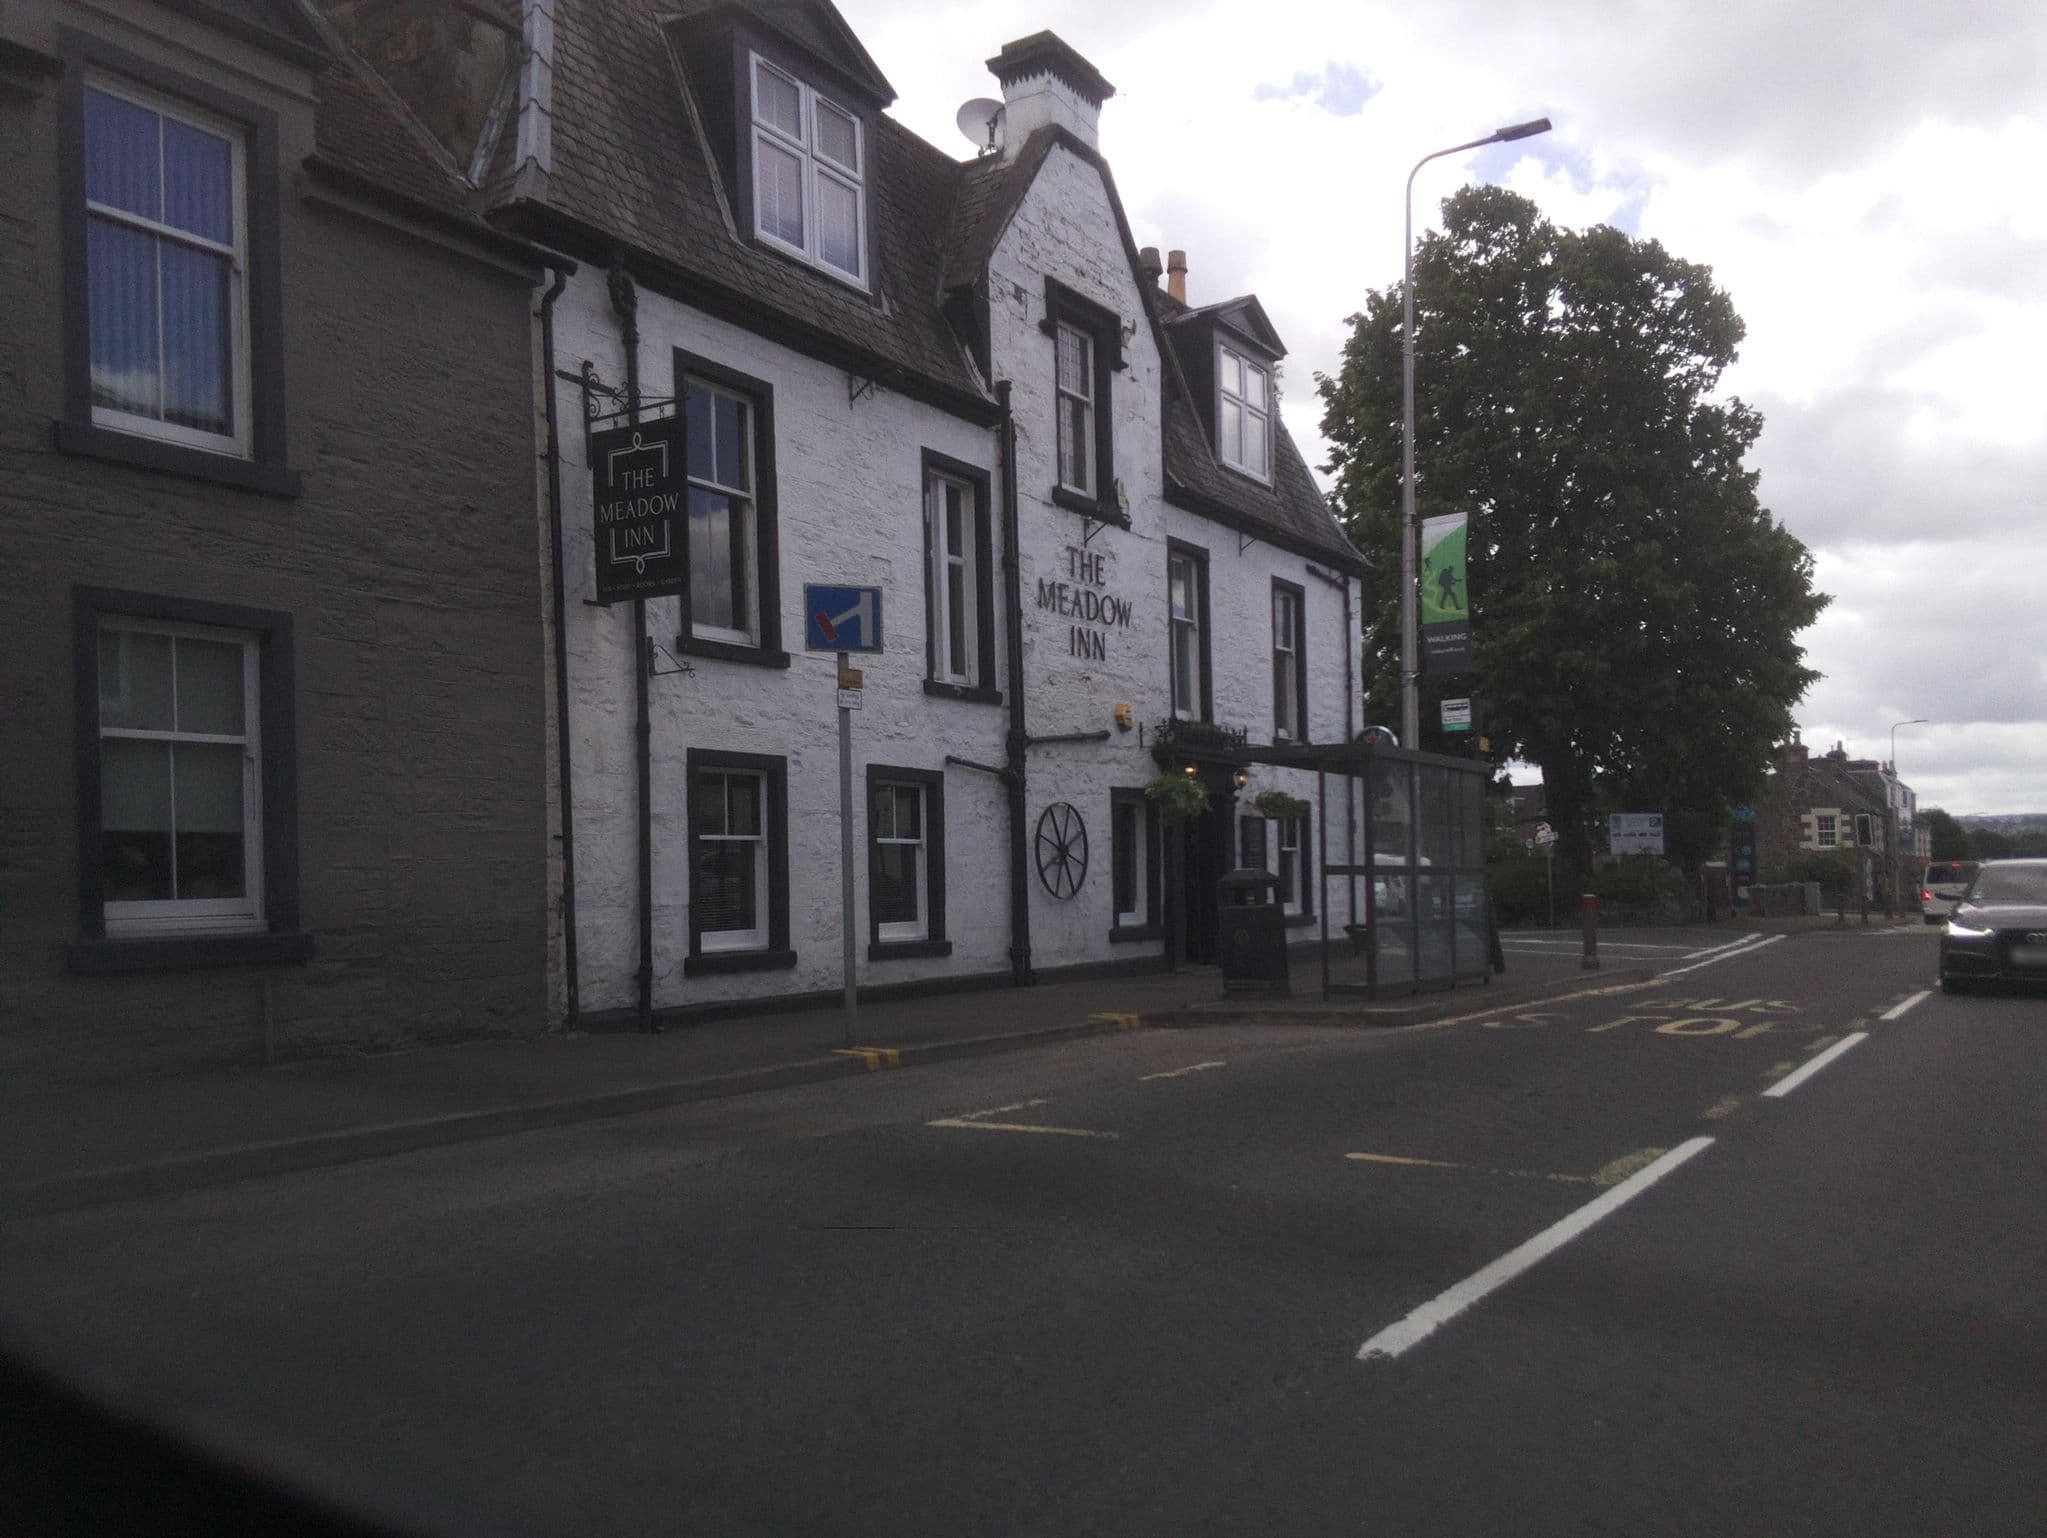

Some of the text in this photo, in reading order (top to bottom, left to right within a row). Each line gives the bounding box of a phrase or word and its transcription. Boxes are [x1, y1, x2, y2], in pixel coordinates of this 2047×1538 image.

[623, 468, 655, 490] THE
[601, 493, 679, 522] MEADOW
[624, 525, 655, 548] INN
[1066, 545, 1106, 587] THE
[1036, 577, 1133, 629] MEADOW
[1069, 625, 1106, 662] INN
[1427, 633, 1467, 643] WALKING
